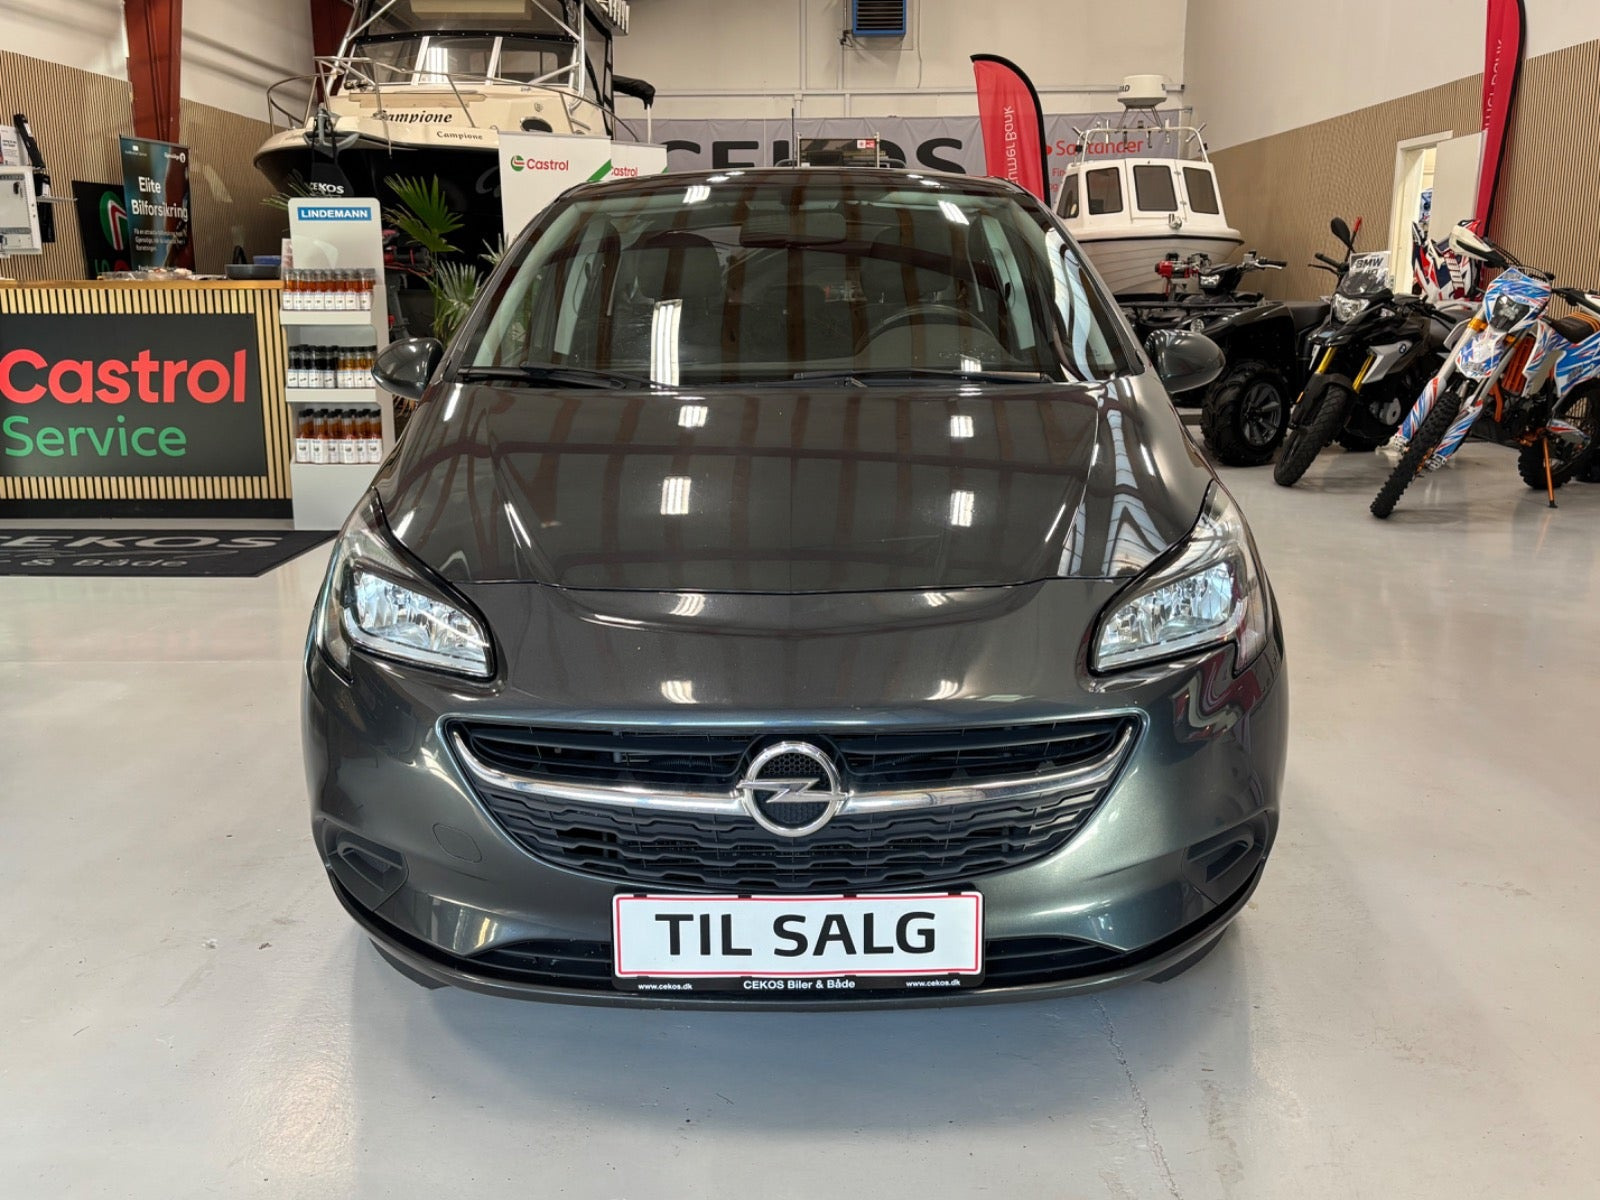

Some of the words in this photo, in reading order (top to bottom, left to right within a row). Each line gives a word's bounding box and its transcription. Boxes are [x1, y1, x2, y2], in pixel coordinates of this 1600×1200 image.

[381, 109, 453, 124] ampione
[436, 130, 483, 140] Campione
[1056, 140, 1144, 156] Satander
[526, 158, 569, 172] Castrol
[611, 166, 638, 177] astrol
[138, 176, 161, 194] Elite
[131, 199, 188, 222] Bilforsikring
[301, 209, 368, 218] LINDEMANN
[0, 349, 246, 404] Castrol
[2, 415, 187, 457] Service
[0, 536, 283, 548] EKOS
[655, 913, 752, 956] TIL
[772, 911, 936, 957] SALG
[637, 983, 694, 991] www.cekos.dk
[743, 980, 785, 990] CEKOS
[787, 980, 812, 989] Biler
[815, 980, 824, 989] &
[827, 979, 856, 989] Både
[905, 979, 961, 987] www.cekos.dk
